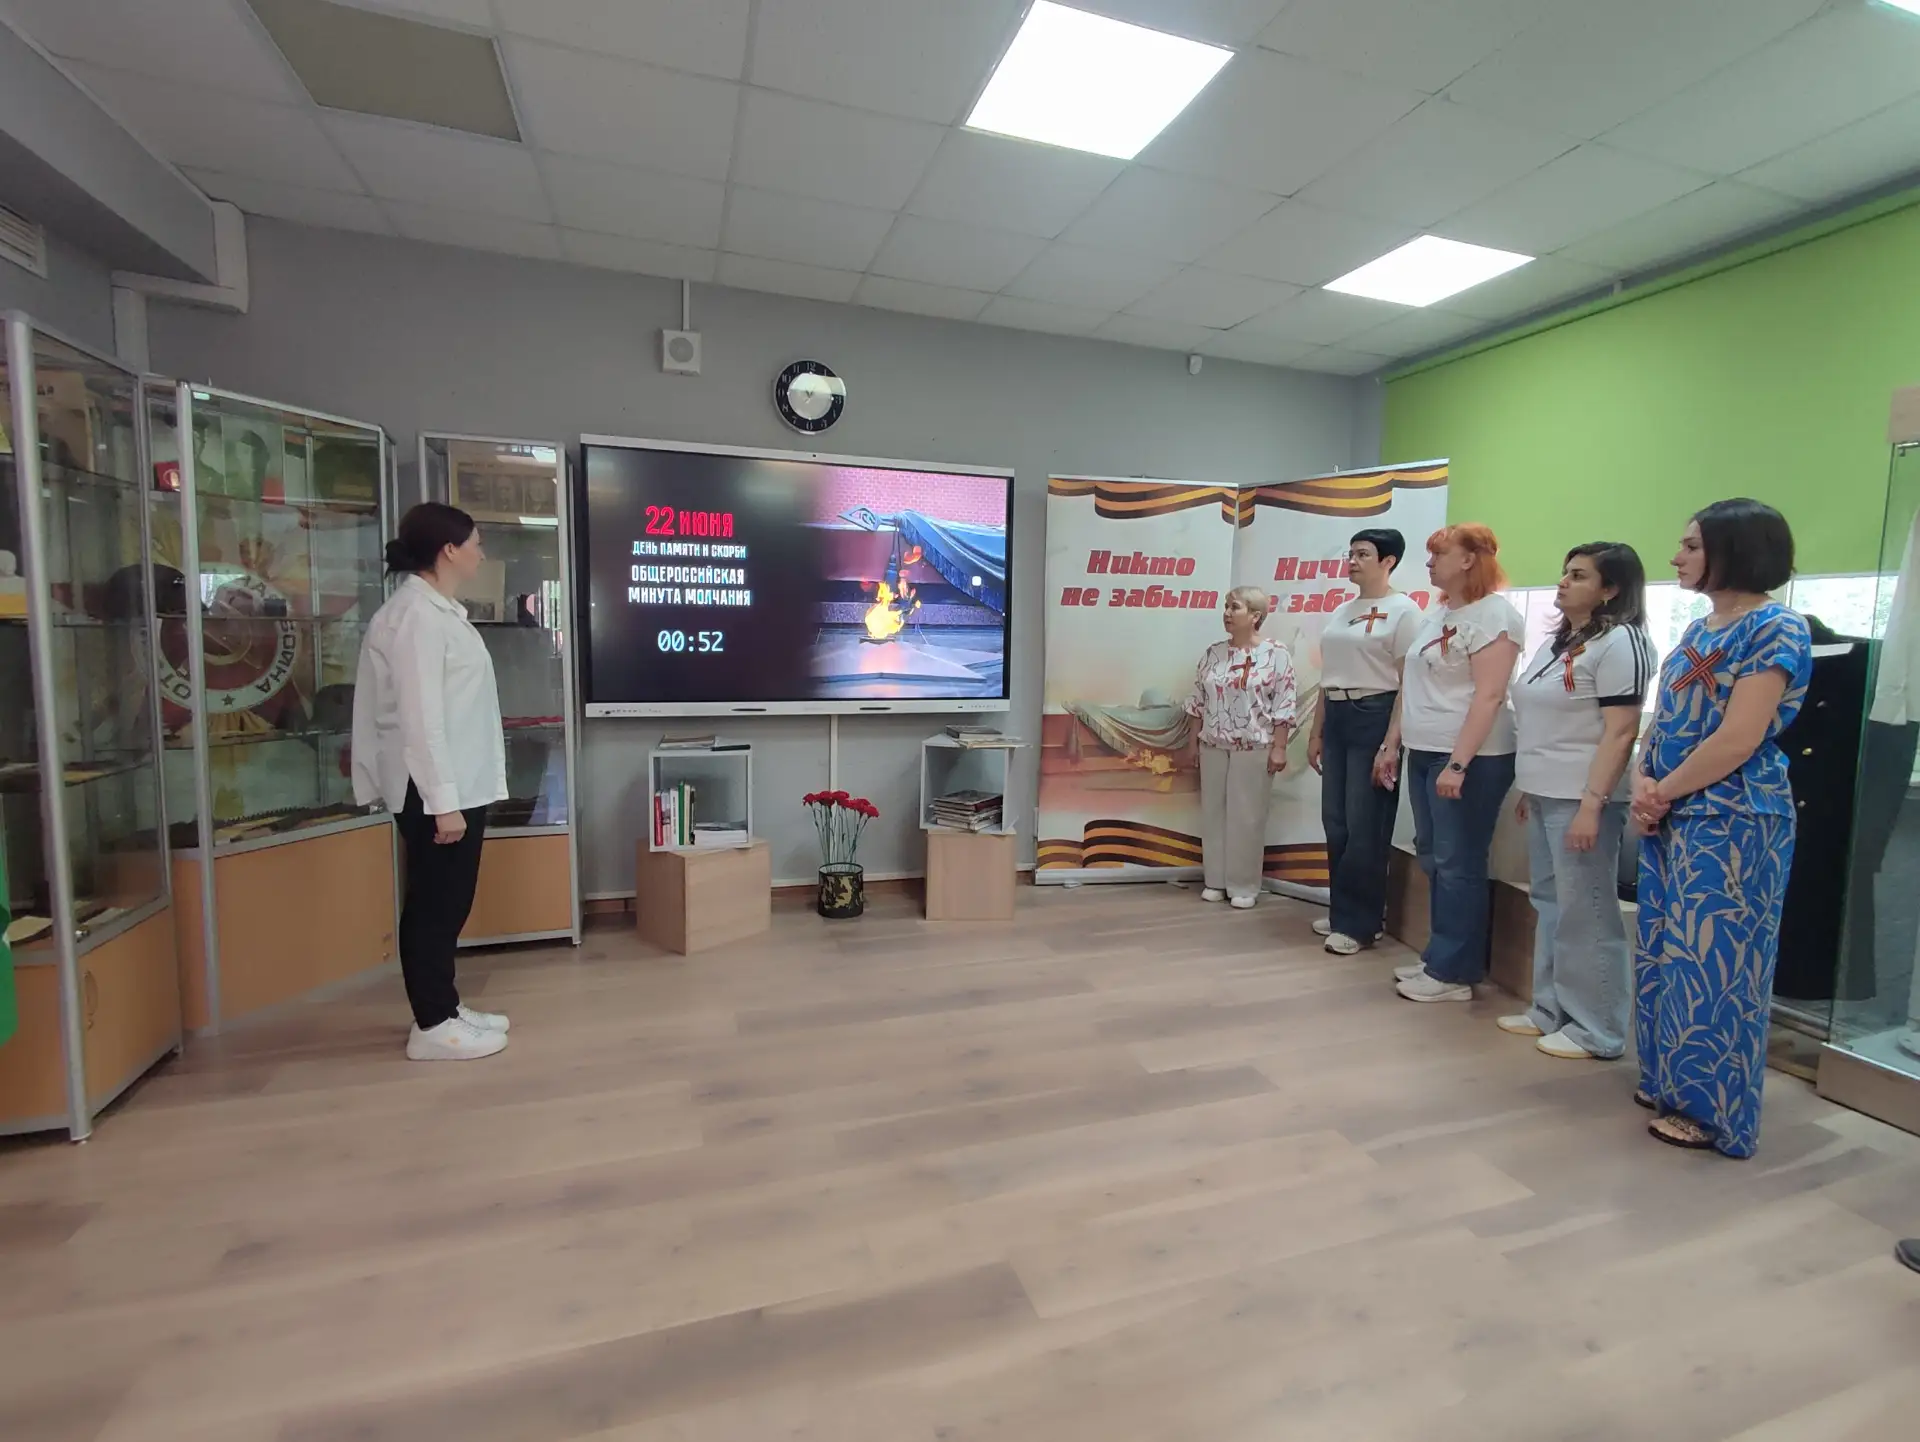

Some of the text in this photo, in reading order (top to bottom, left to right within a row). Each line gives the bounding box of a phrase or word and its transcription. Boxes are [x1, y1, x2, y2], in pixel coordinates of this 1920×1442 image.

[645, 505, 733, 538] 22 ИЮНЯ
[632, 541, 747, 559] ДЕНЬ ПАМЯТИ И СКОРБИ
[631, 564, 745, 585] ОБЩЕРОССИЙСКАЯ
[1087, 549, 1196, 577] Никто
[1274, 556, 1350, 581] Нич
[628, 586, 752, 606] МИНУТА МОЛЧАНИЯ
[1060, 585, 1219, 609] не забыт
[657, 630, 724, 652] 00:52
